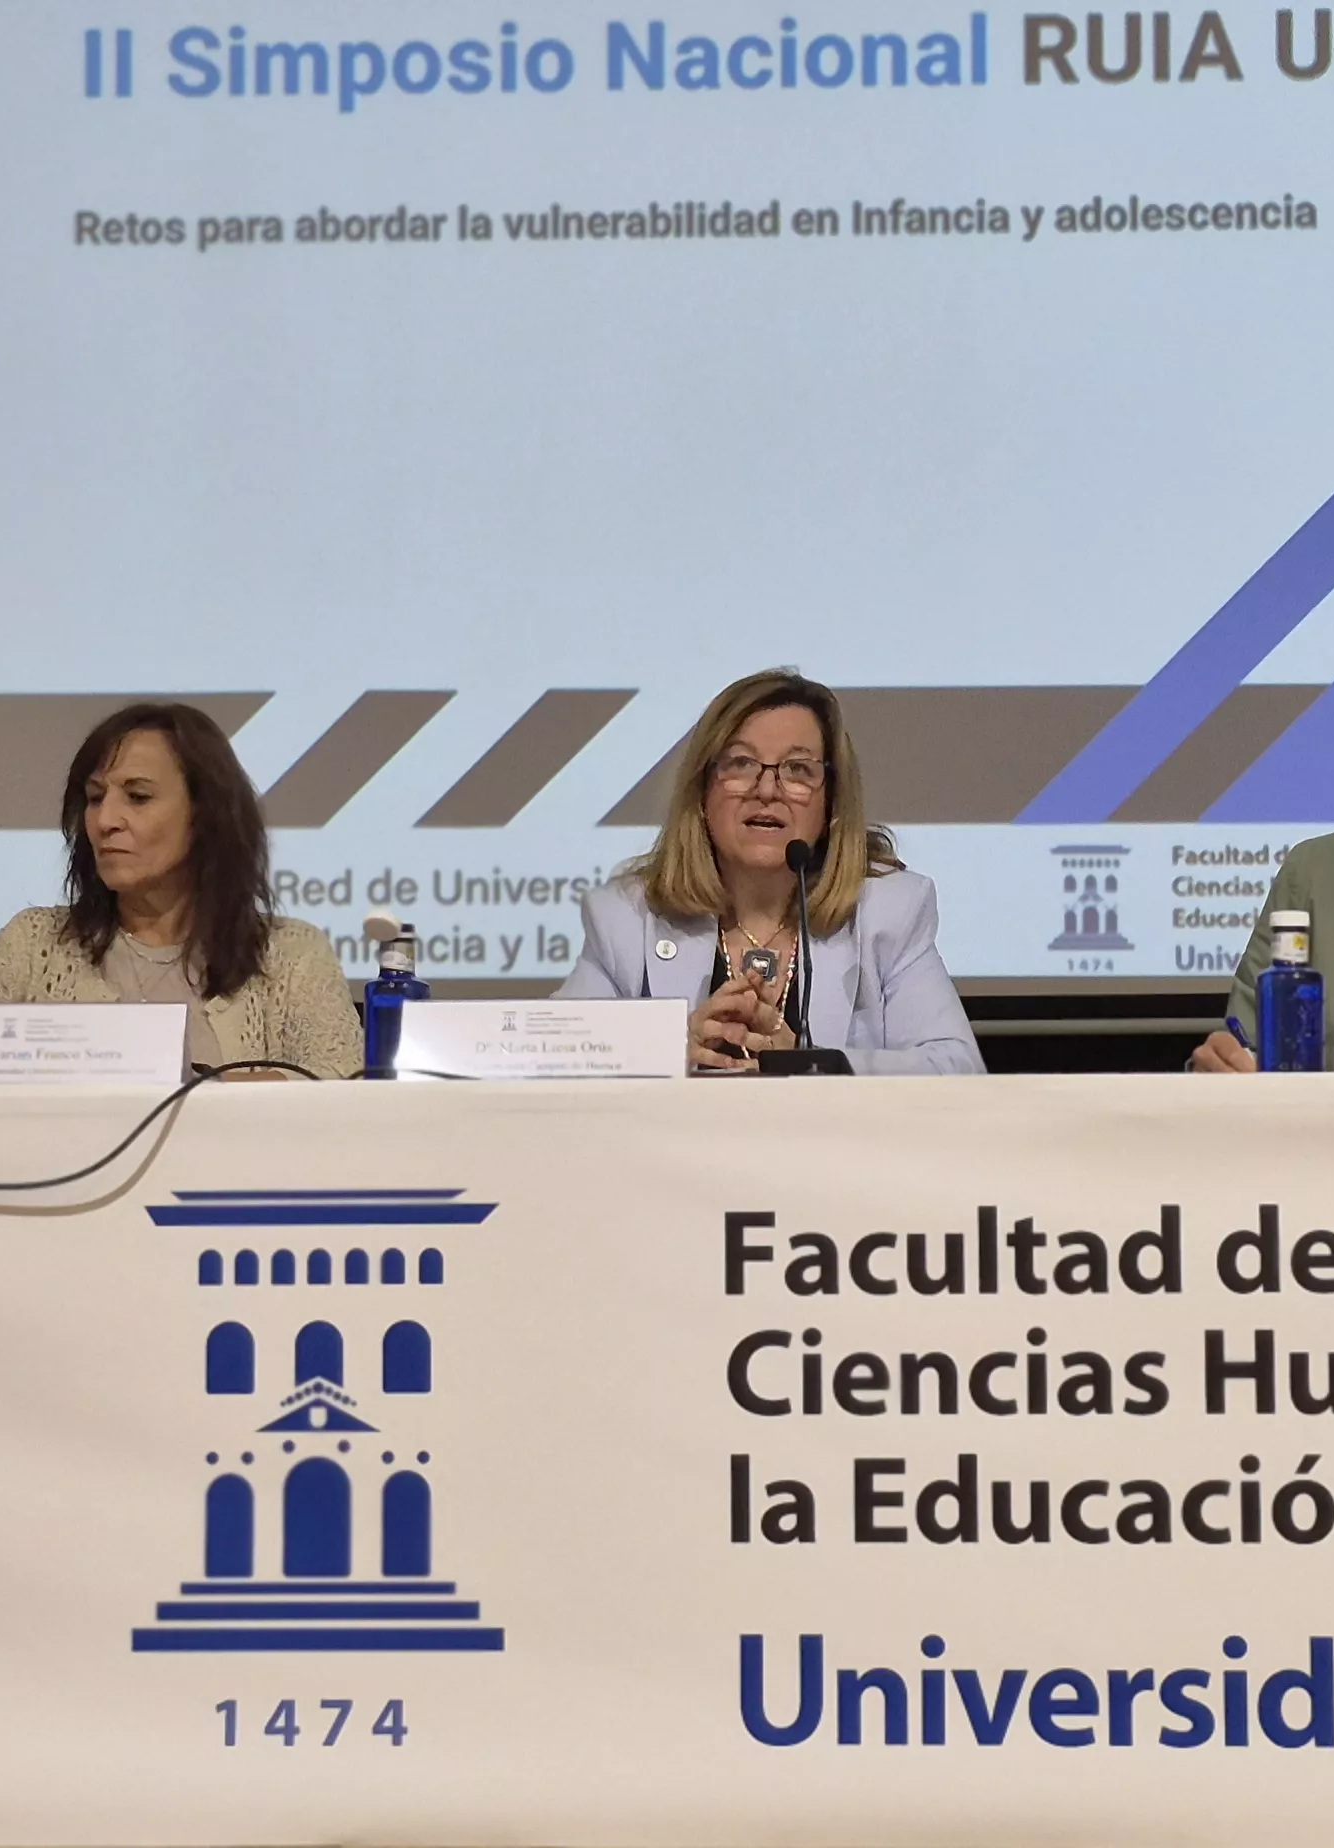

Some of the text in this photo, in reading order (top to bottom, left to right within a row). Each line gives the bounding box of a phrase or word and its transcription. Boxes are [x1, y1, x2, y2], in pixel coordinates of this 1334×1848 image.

[84, 28, 132, 99] II
[167, 22, 574, 114] Simposio
[606, 13, 988, 91] Nacional
[1023, 11, 1245, 86] RUIA
[74, 193, 1318, 253] Retos para abordar la vulnerabilidad en Infancia y adolescencia
[1171, 843, 1270, 866] Facultad
[273, 866, 602, 906] Red de Universi
[1171, 875, 1265, 898] Ciencias
[1171, 906, 1260, 929] Educaci
[499, 934, 523, 972] y
[537, 924, 570, 963] la
[1067, 957, 1114, 972] 1474
[723, 1205, 1183, 1296] Facultad
[725, 1327, 1170, 1418] Ciencias
[729, 1453, 817, 1546] la
[214, 1698, 409, 1747] 1474
